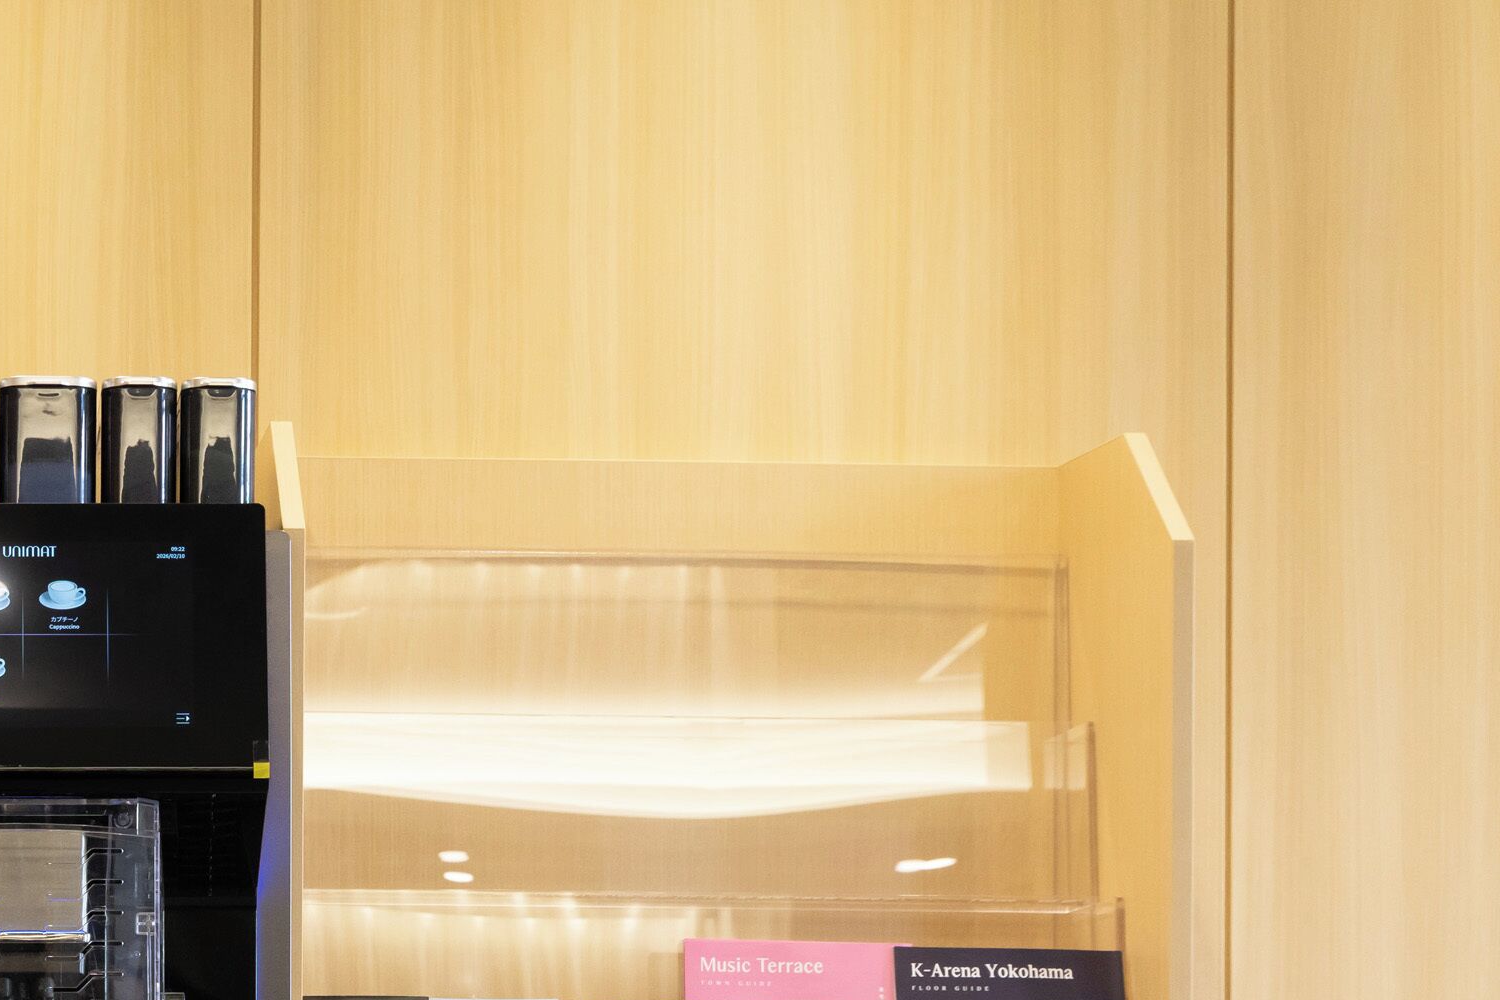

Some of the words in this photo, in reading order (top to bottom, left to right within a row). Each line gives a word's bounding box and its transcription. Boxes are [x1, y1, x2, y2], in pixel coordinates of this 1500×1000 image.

[2, 545, 57, 558] UNIMAT
[699, 956, 752, 974] Music
[756, 956, 825, 974] Terrace
[909, 962, 982, 979] K-Arena
[984, 963, 1075, 981] Yokohama
[910, 984, 948, 992] FLOOR
[953, 984, 991, 993] GUIDE
